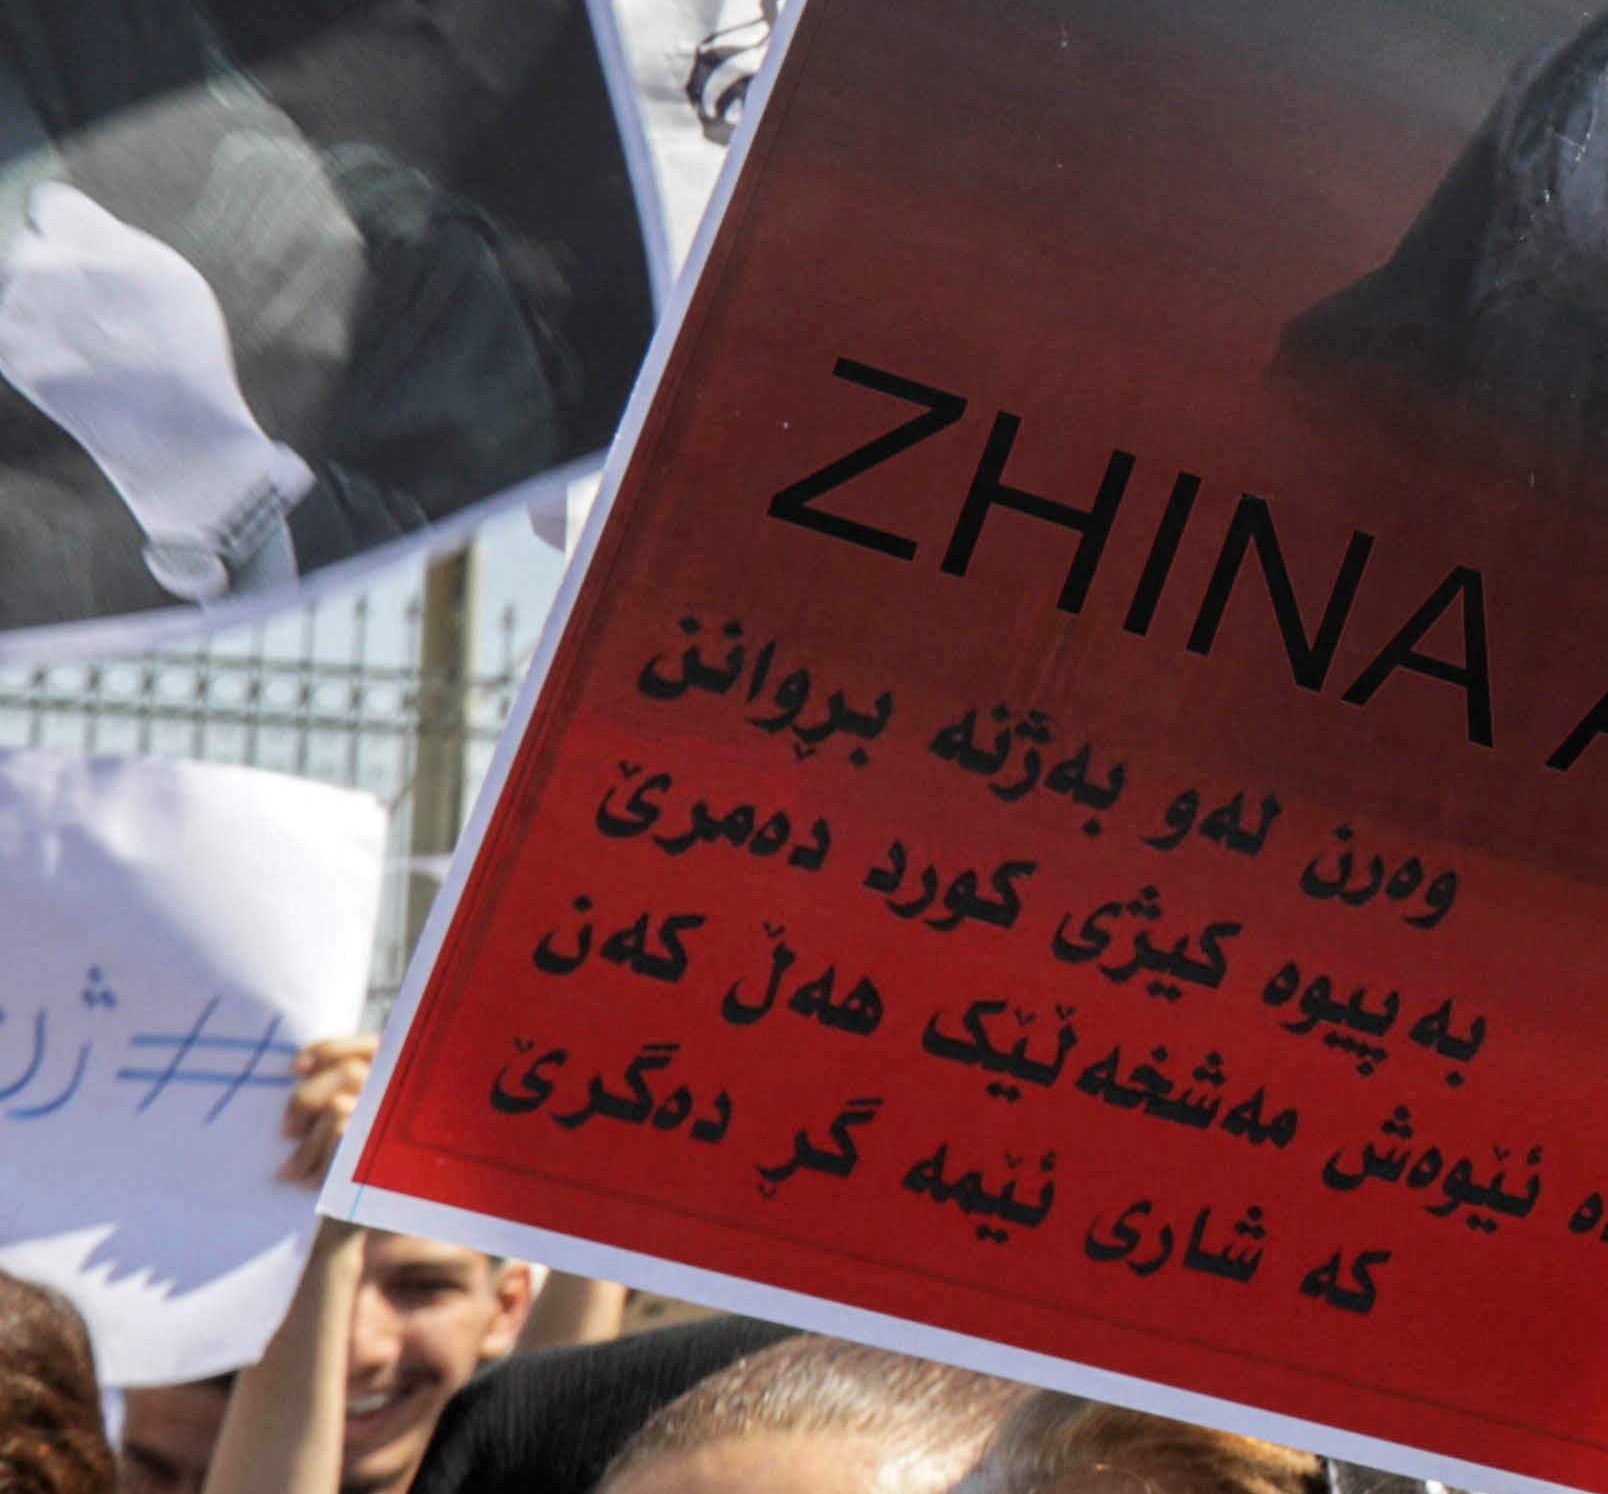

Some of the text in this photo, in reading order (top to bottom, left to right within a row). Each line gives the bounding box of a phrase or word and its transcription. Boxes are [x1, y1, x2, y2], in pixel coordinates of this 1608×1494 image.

[767, 356, 1494, 749] ZHINA
[862, 839, 1038, 931] کورد
[1301, 825, 1459, 930] وەرن
[1084, 1199, 1267, 1284] شاری
[1300, 1250, 1391, 1315] کە
